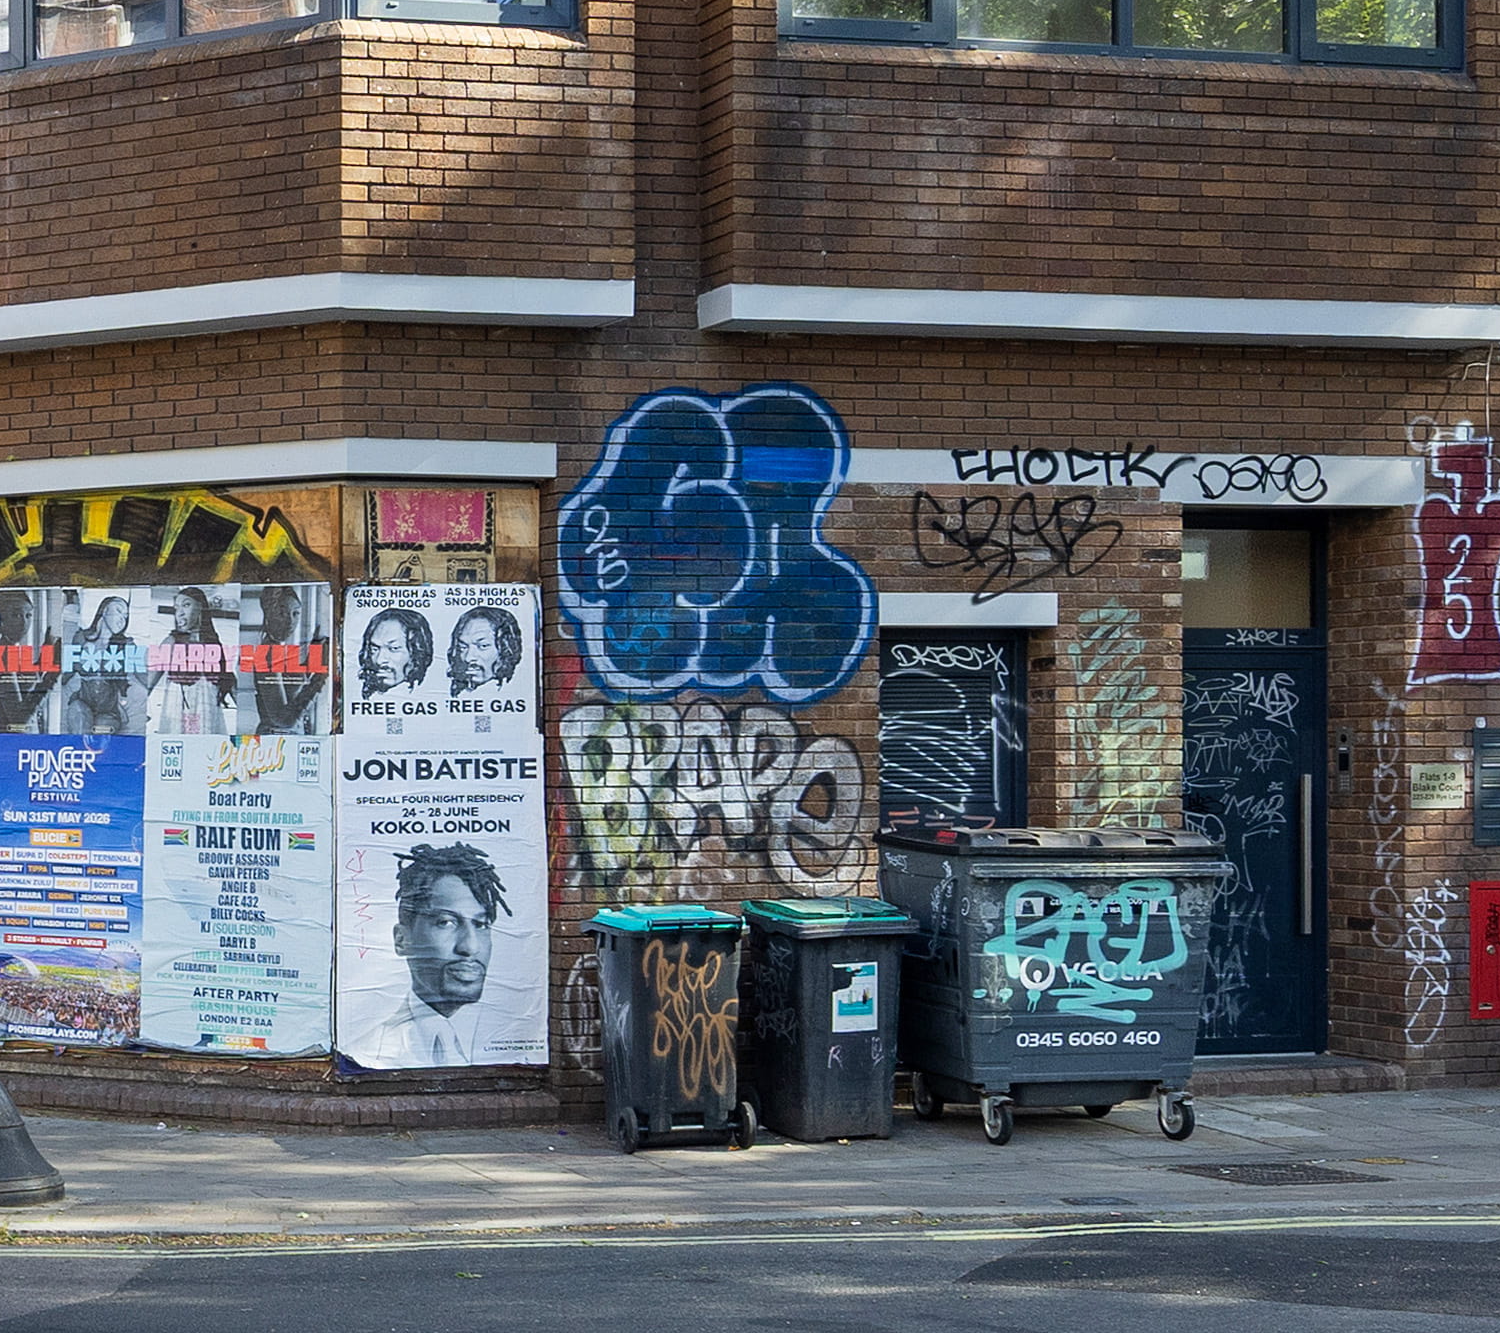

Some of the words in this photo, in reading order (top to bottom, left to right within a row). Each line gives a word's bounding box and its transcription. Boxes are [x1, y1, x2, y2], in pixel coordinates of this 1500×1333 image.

[352, 589, 373, 598] GAS
[376, 589, 387, 598] IS
[390, 589, 419, 598] HIGH
[421, 589, 437, 598] AS
[465, 587, 475, 596] IS
[479, 587, 508, 596] HIGH
[511, 587, 526, 596] AS
[356, 599, 395, 608] SNOOP
[398, 599, 431, 608] DOGG
[445, 597, 483, 607] SNOOP
[487, 597, 520, 607] DOGG
[149, 643, 239, 673] MARRY
[240, 644, 329, 674] KILL
[351, 702, 396, 716] FREE
[402, 702, 437, 716] GAS
[490, 699, 526, 713] GAS
[162, 745, 183, 755] SAT
[299, 746, 319, 755] 4PM
[18, 746, 97, 775] PIONEER
[165, 757, 179, 767] 06
[206, 737, 286, 789] Lifted
[302, 757, 318, 766] TILL
[161, 768, 182, 778] JUN
[342, 758, 407, 781] JON
[415, 757, 537, 780] BATISTE
[28, 771, 85, 789] PLAYS
[1420, 772, 1441, 781] Flats
[1443, 772, 1456, 781] 1-9
[1412, 783, 1437, 792] Blake
[1438, 782, 1463, 792] Court
[30, 792, 81, 802] FESTIVAL
[209, 791, 237, 807] Boat
[239, 791, 272, 809] Party
[356, 796, 400, 805] SPECIAL
[401, 795, 430, 804] FOUR
[432, 794, 464, 804] NIGHT
[466, 793, 525, 803] RESIDENCY
[3, 810, 28, 823] SUN
[28, 811, 56, 824] 31ST
[57, 812, 82, 824] MAY
[172, 810, 201, 823] FLYING
[203, 810, 212, 823] IN
[214, 811, 239, 823] FROM
[240, 812, 271, 824] SOUTH
[271, 813, 304, 825] AFRICA
[402, 807, 417, 818] 24
[430, 807, 442, 818] 28
[443, 806, 479, 817] JUNE
[432, 819, 511, 834] LONDON
[32, 832, 68, 843] BUCIE
[196, 826, 236, 849] RALF
[241, 827, 281, 851] GUM
[92, 853, 133, 863] TERMINAL
[198, 852, 234, 866] GROOVE
[235, 853, 280, 867] ASSASSIN
[208, 866, 236, 879] GAVIN
[237, 867, 270, 881] PETERS
[221, 881, 249, 893] ANGIE
[249, 882, 257, 894] B
[218, 895, 239, 907] CAFE
[240, 896, 259, 908] 432
[210, 907, 234, 921] BILLY
[235, 908, 266, 922] COCKS
[200, 921, 211, 933] KJ
[212, 921, 276, 938] (SOULFUSION)
[219, 936, 249, 949] DARYL
[249, 937, 257, 950] B
[223, 951, 255, 963] SABRINA
[257, 953, 281, 965] CHYLD
[173, 962, 217, 974] CELEBRATING
[266, 967, 300, 979] BIRTHDAY
[193, 987, 234, 1001] AFTER
[237, 989, 279, 1003] PARTY
[236, 1003, 278, 1017] HOUSE
[199, 1014, 238, 1026] LONDON
[8, 1023, 98, 1040] PIONEERPLAYS.COM
[1016, 1033, 1063, 1047] 0345
[1068, 1032, 1118, 1046] 6060
[1122, 1031, 1161, 1045] 460
